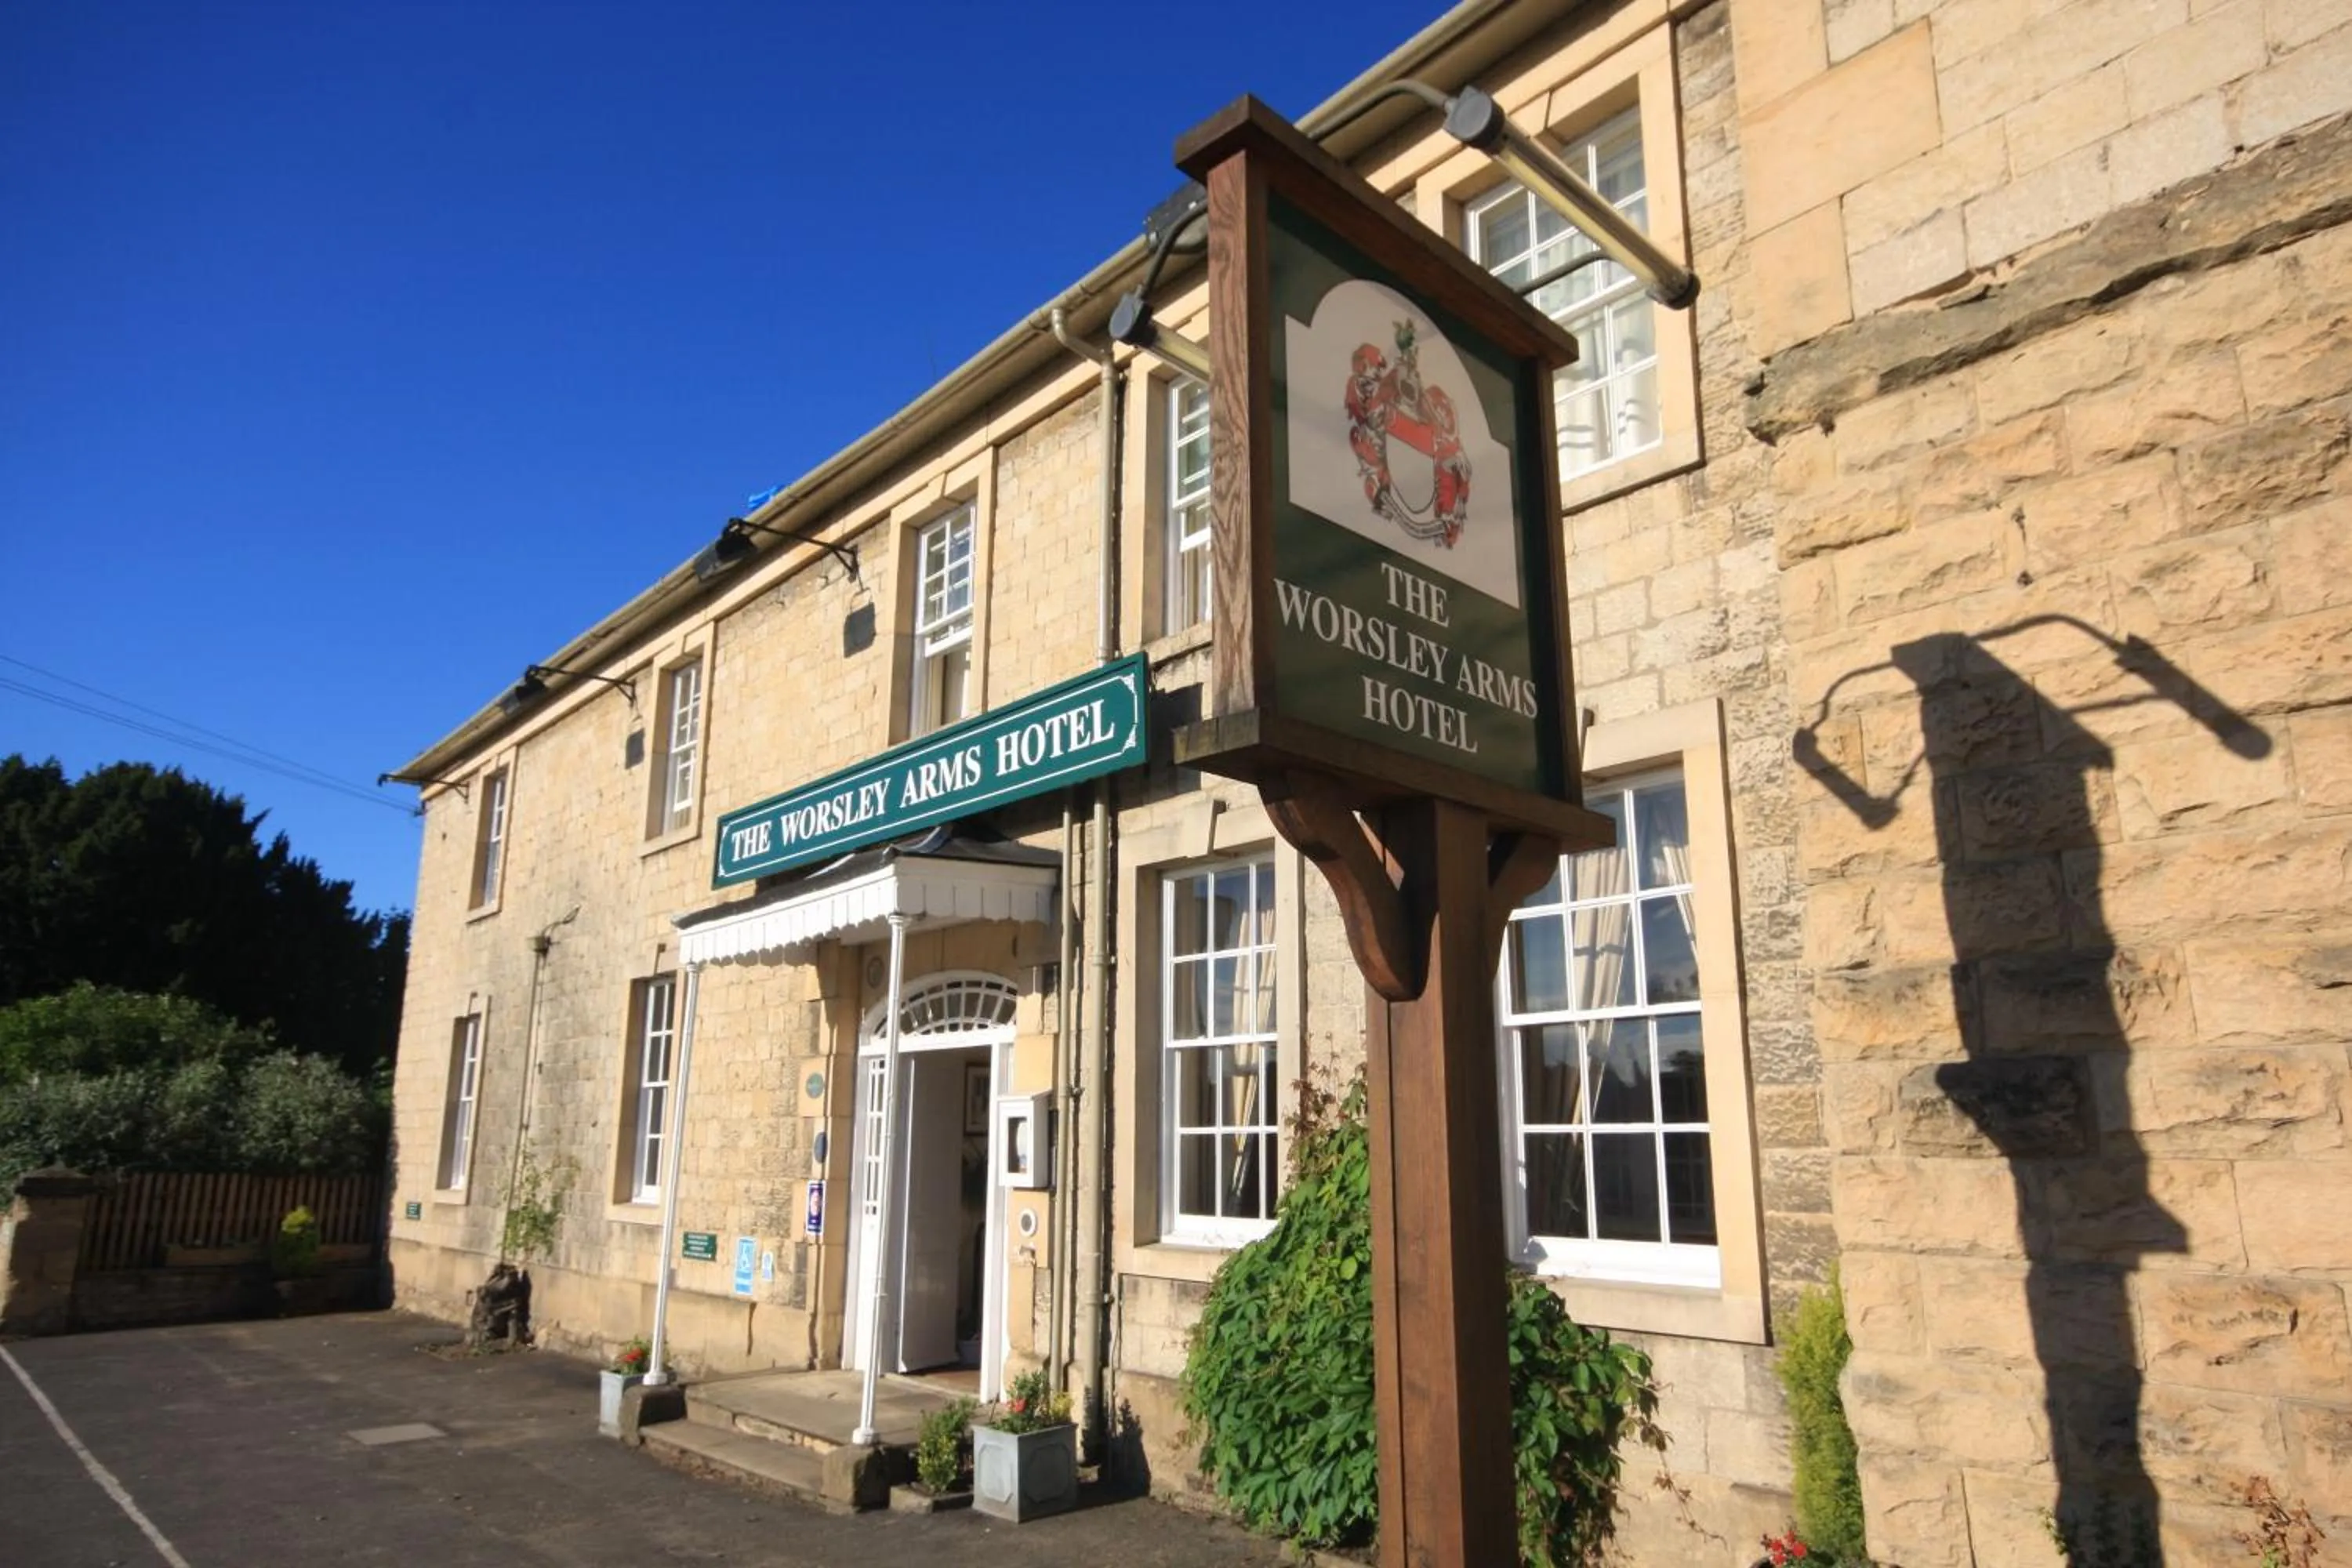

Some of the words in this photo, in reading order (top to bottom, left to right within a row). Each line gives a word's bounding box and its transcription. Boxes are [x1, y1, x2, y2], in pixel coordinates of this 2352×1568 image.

[1273, 578, 1448, 684] WORSLEY
[1456, 654, 1537, 719] ARMS
[1381, 562, 1450, 627] THE
[1361, 675, 1478, 753] HOTEL
[731, 819, 771, 862] THE
[780, 778, 891, 844] WORSLEY
[900, 744, 982, 808] ARMS
[996, 699, 1114, 777] HOTEL
